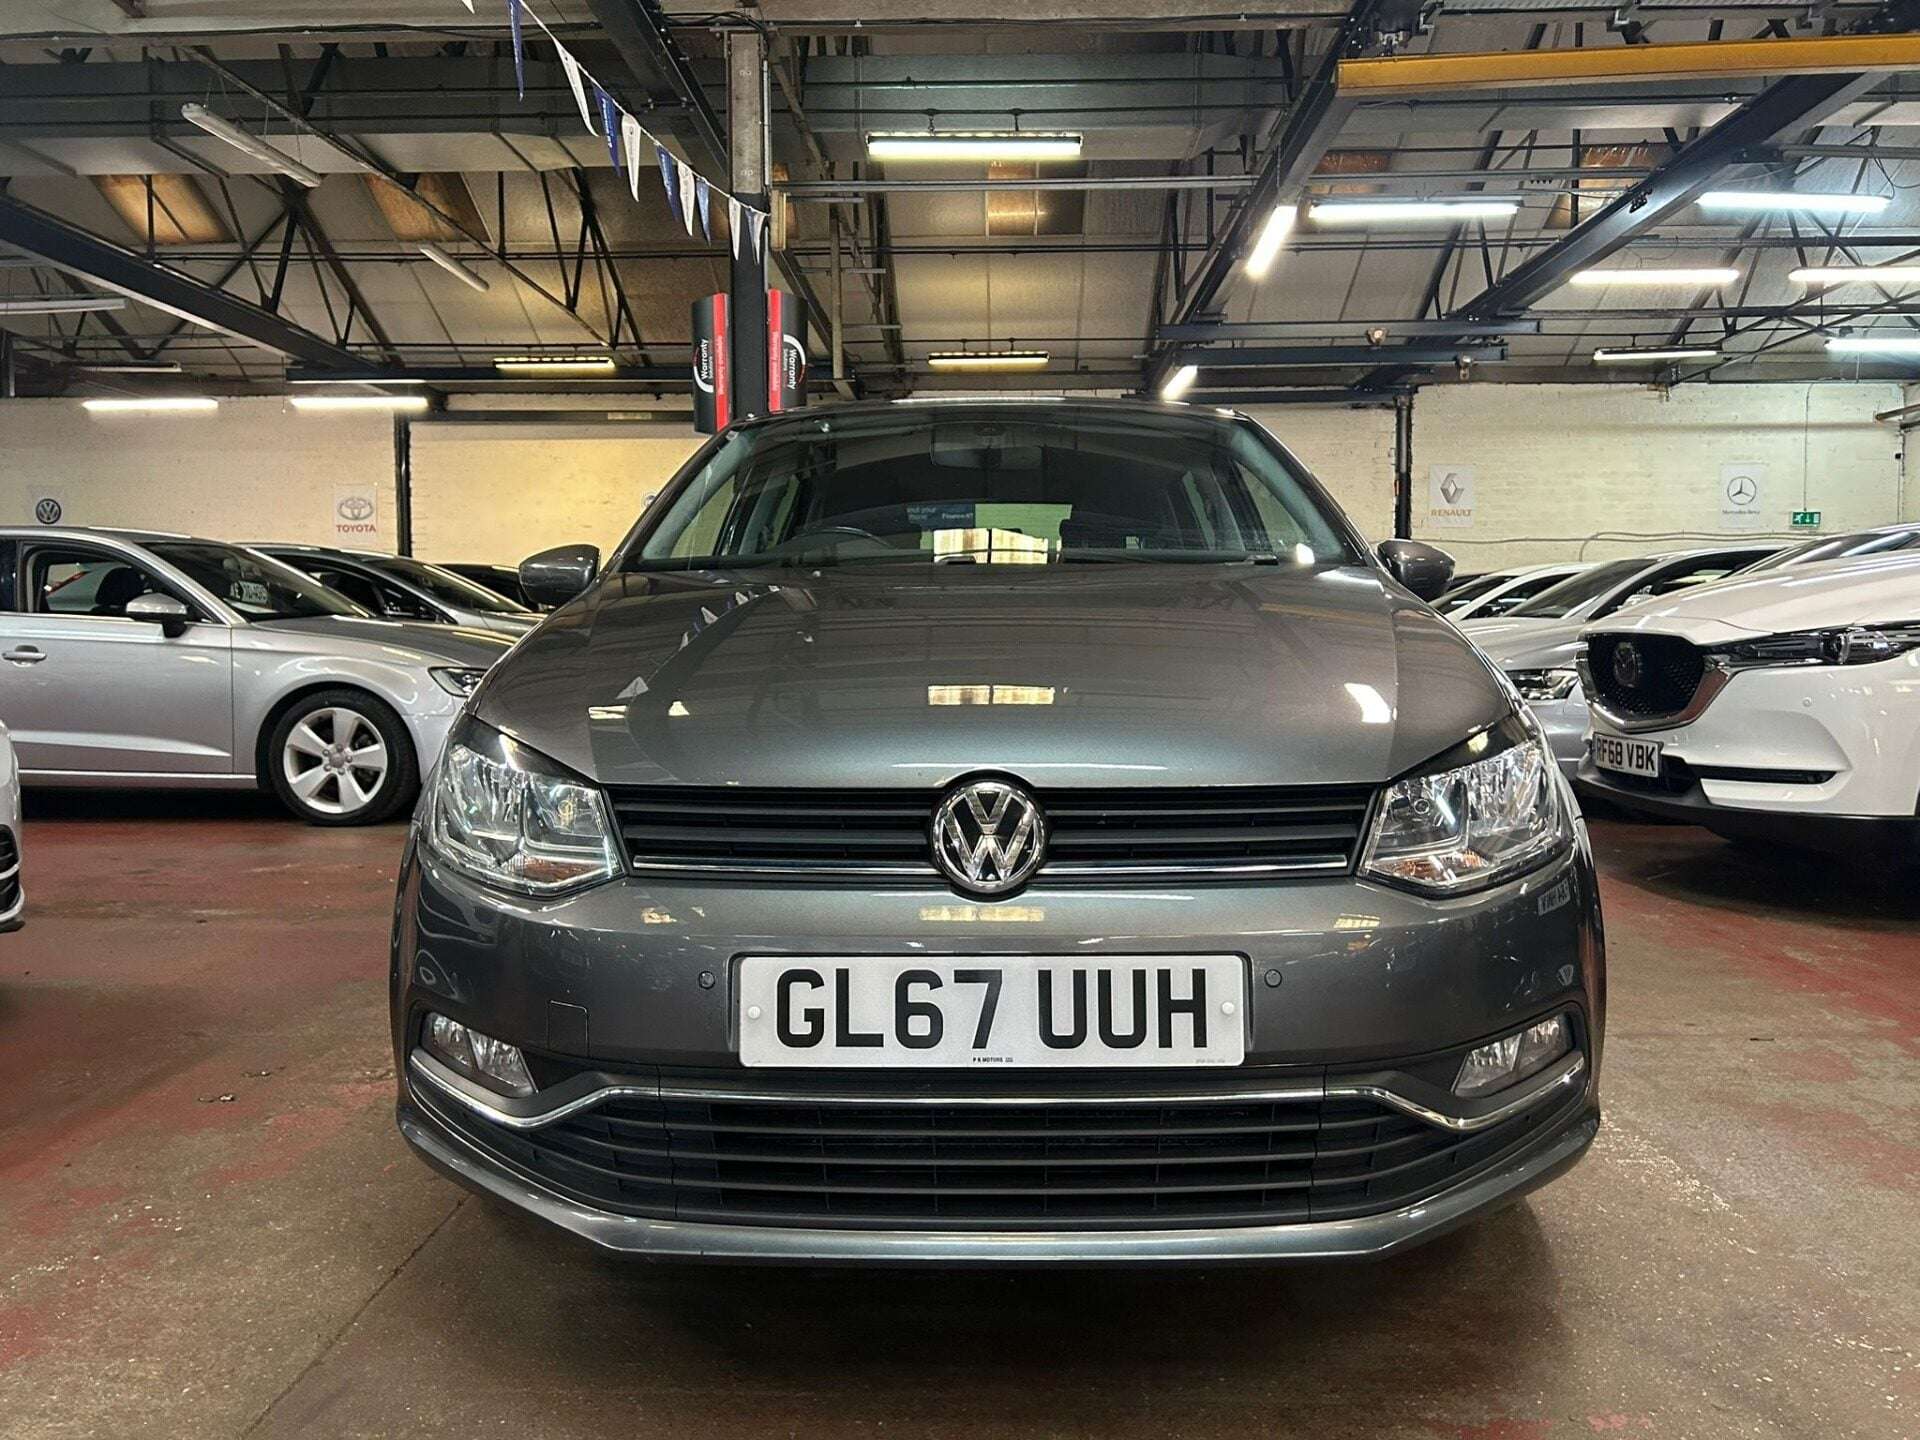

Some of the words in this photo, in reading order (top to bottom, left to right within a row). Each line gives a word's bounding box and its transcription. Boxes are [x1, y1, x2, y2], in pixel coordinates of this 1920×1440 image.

[700, 339, 709, 380] Warranty
[787, 348, 797, 390] Warranty
[335, 523, 377, 533] TOYOTA
[1431, 508, 1472, 517] RENAULT
[1596, 737, 1623, 766] RF68
[1626, 742, 1656, 771] VBK
[775, 968, 1003, 1050] GL67
[1038, 968, 1208, 1049] UUH
